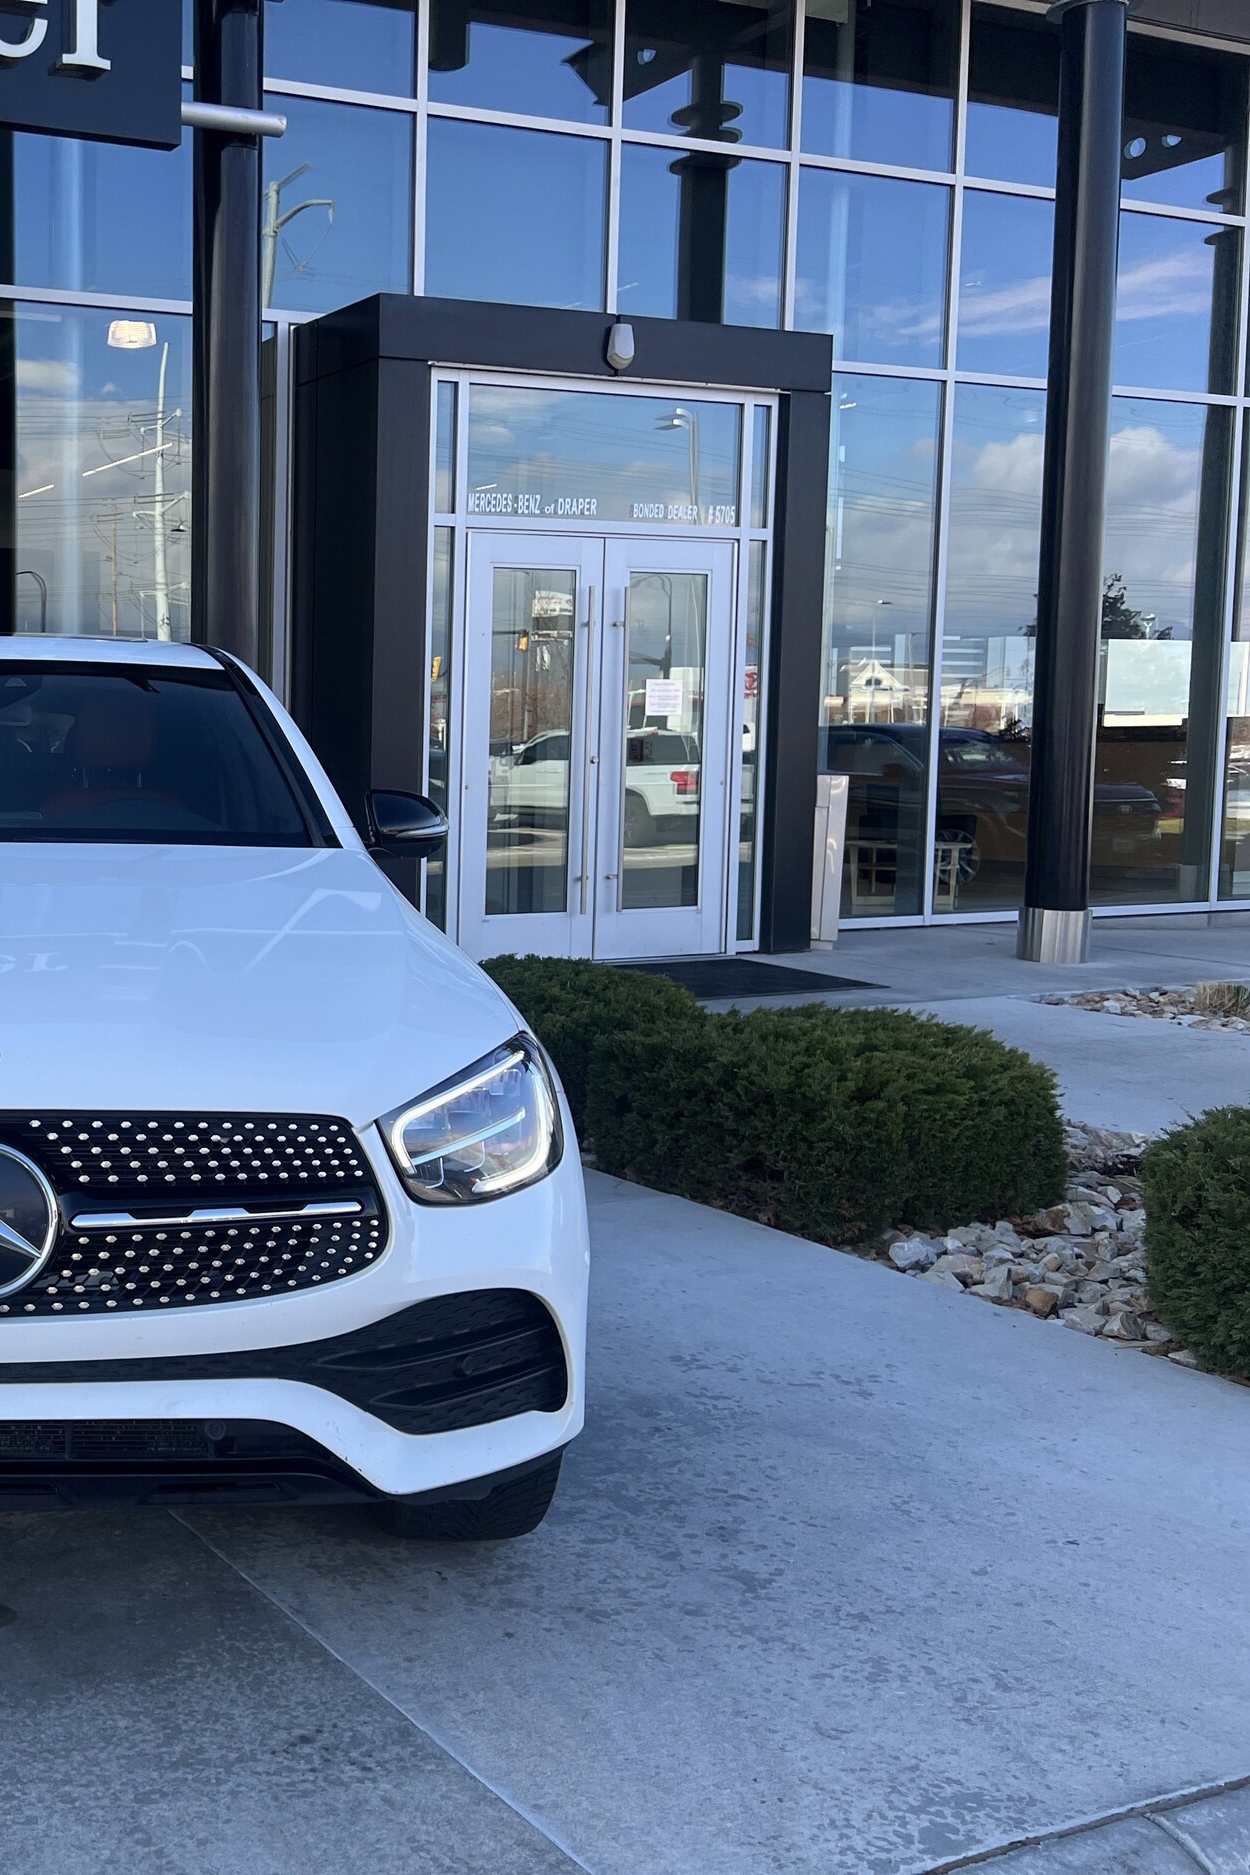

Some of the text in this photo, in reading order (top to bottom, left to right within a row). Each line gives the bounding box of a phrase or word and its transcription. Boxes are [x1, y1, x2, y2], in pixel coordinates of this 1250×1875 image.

[544, 503, 555, 514] of
[557, 497, 597, 516] DRAPER
[633, 503, 665, 519] BONDED
[667, 505, 698, 521] DEALER
